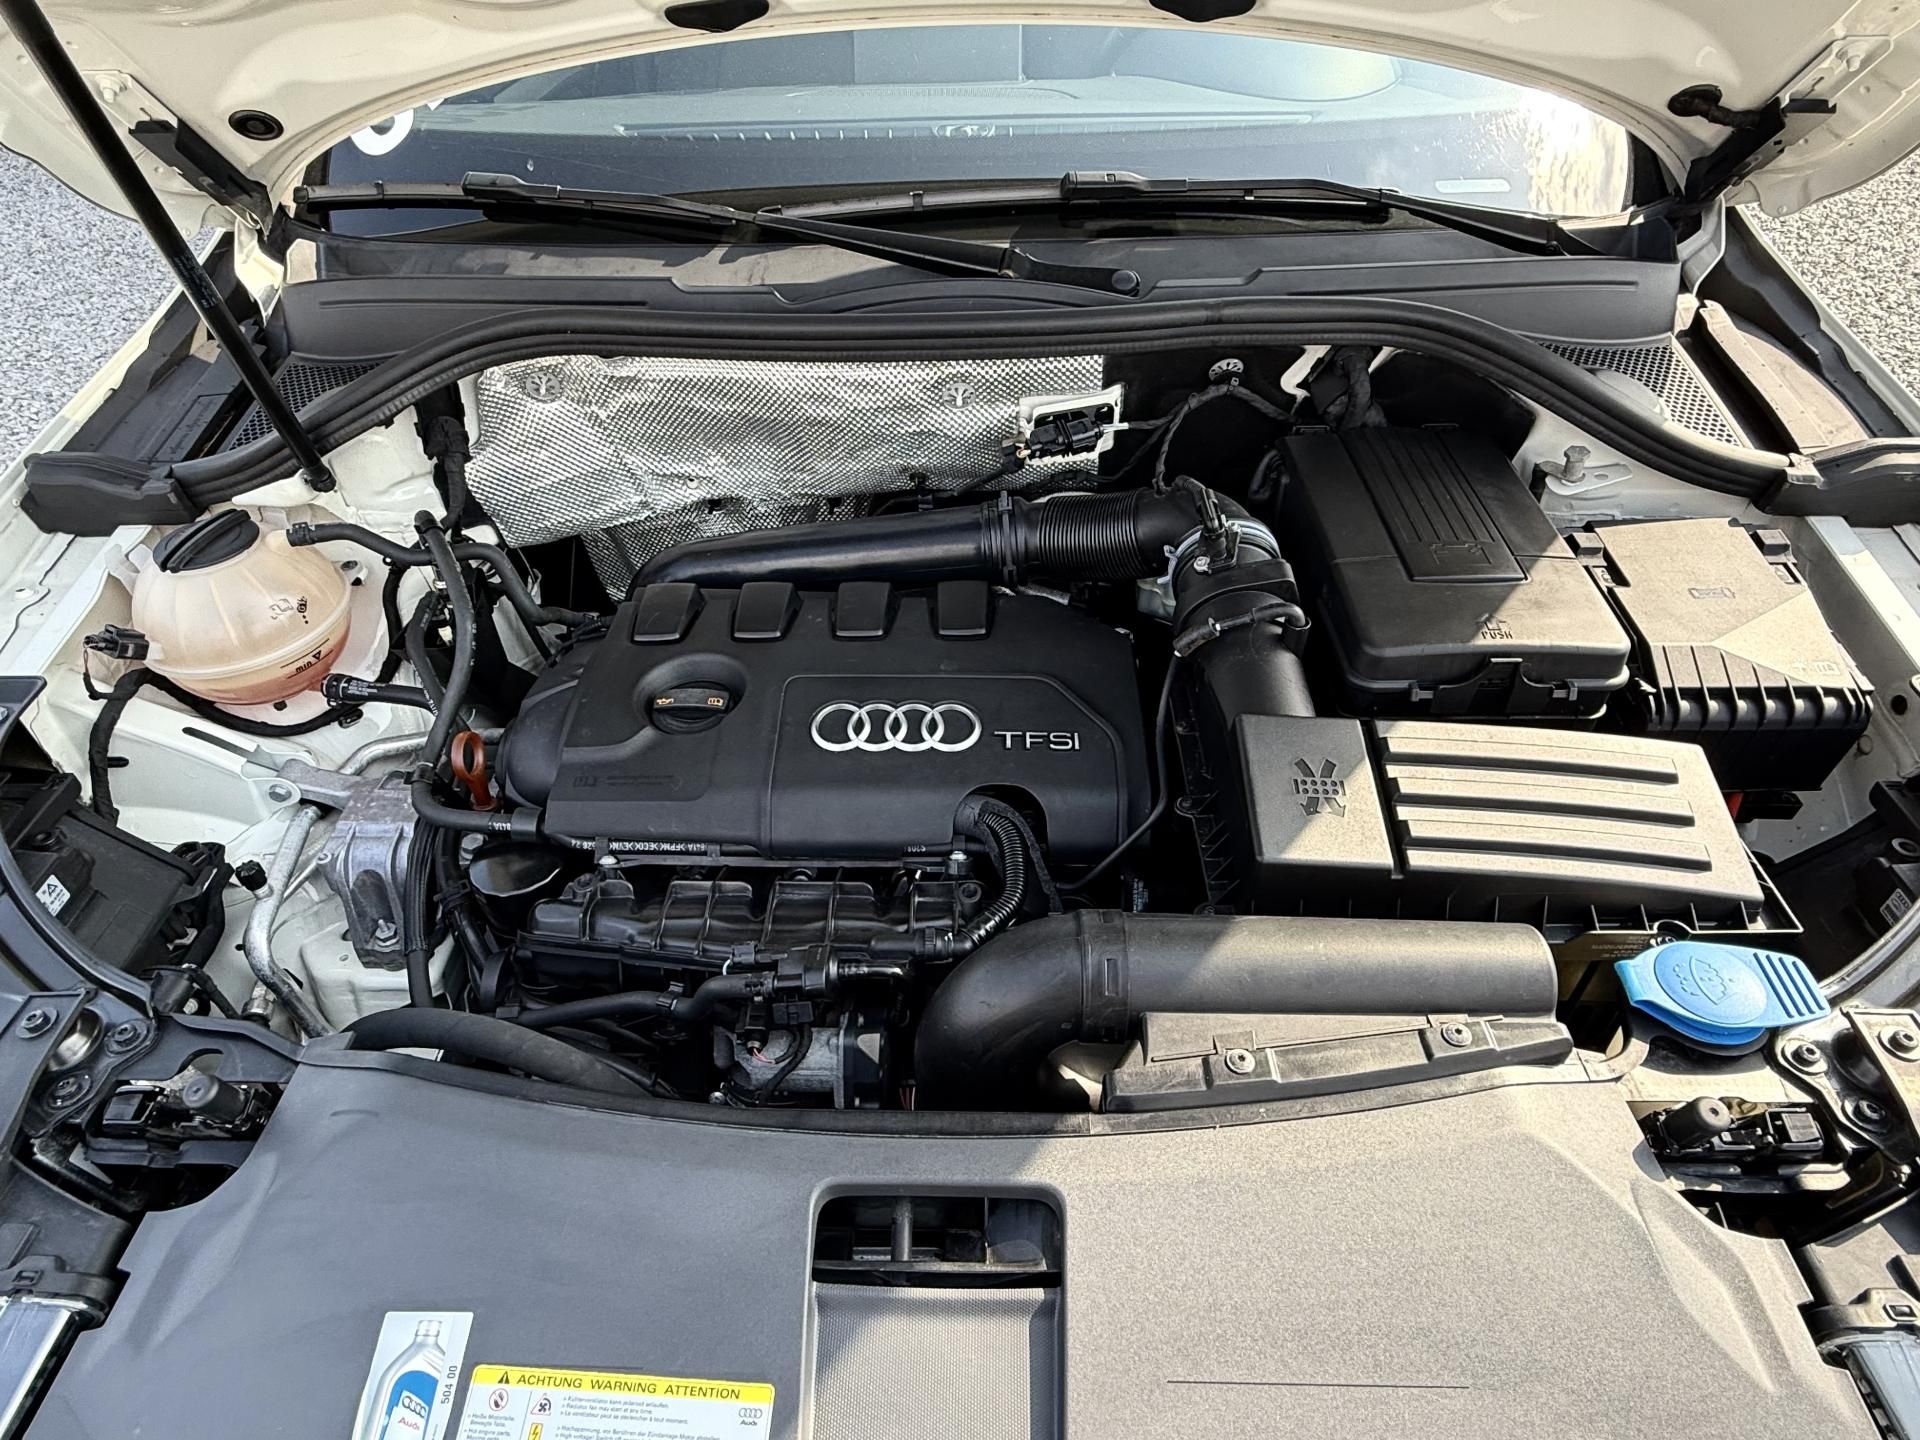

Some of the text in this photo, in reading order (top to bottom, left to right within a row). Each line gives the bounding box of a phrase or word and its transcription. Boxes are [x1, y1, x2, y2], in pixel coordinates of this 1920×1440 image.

[1480, 630, 1514, 640] PUSH
[295, 660, 313, 674] min
[994, 731, 1080, 750] TFSI
[441, 1366, 458, 1404] 504 00
[516, 1374, 740, 1400] ACHTUNG WARNING ATTENTION
[398, 1417, 420, 1430] Audi
